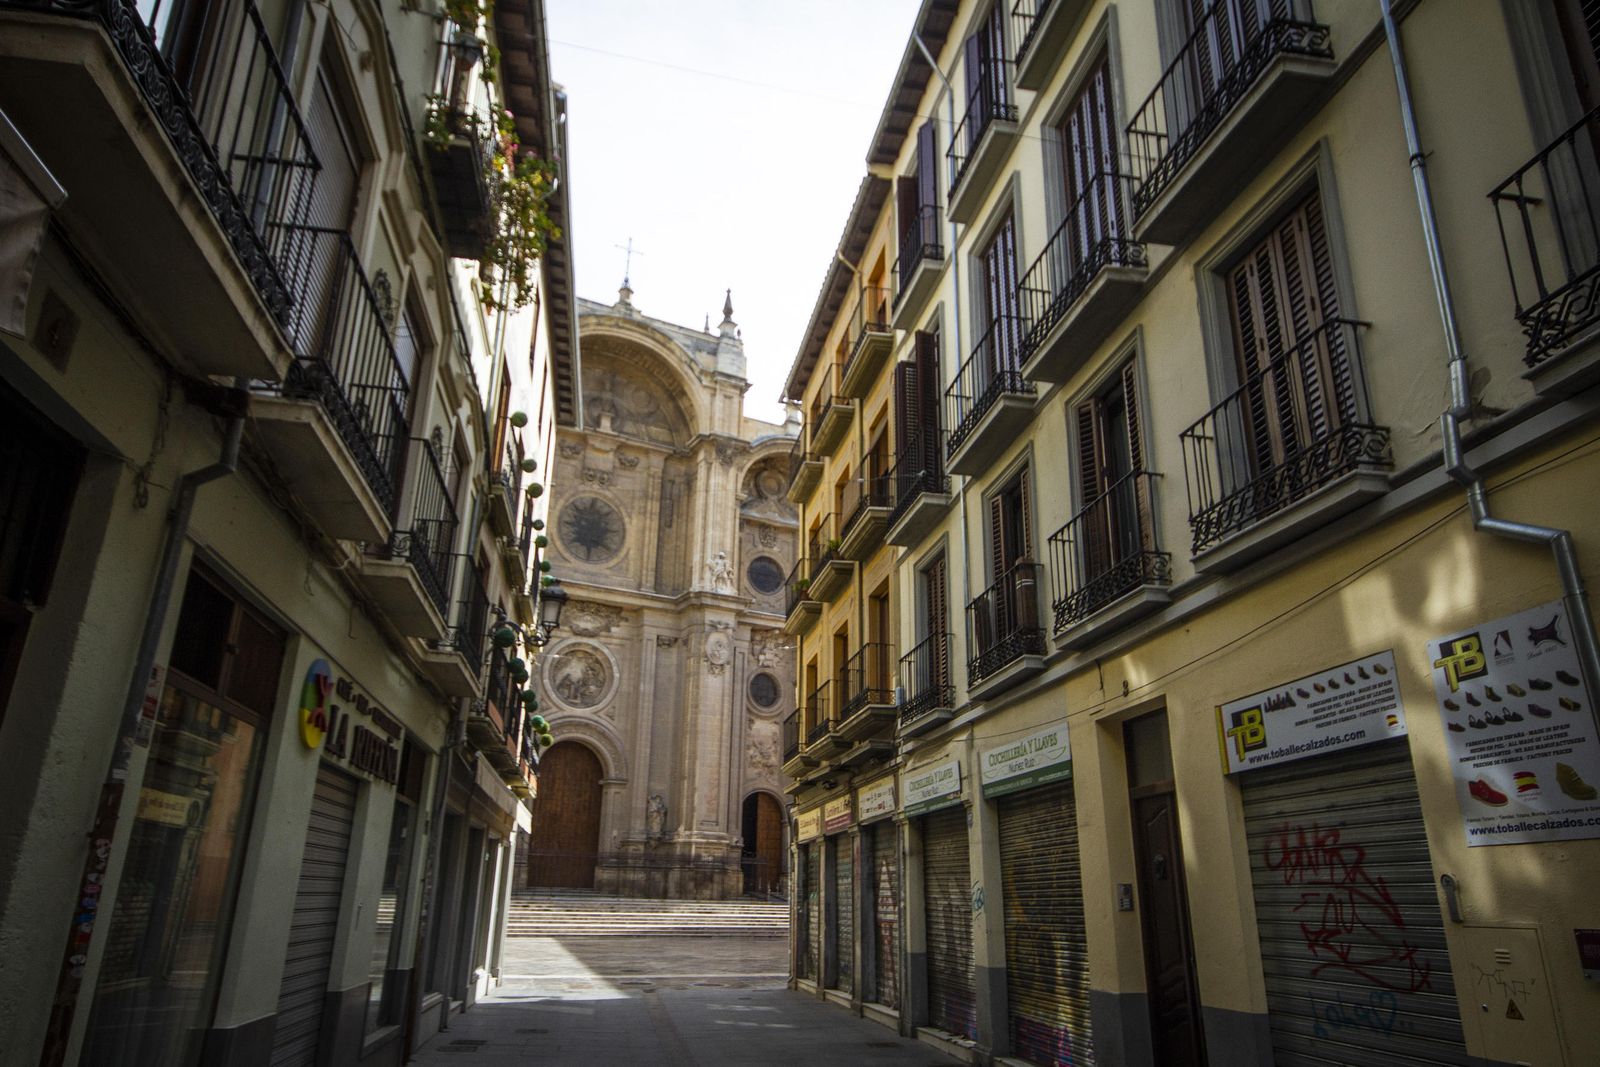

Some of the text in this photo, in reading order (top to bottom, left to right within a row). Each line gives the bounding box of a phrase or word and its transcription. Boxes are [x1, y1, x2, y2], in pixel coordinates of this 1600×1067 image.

[326, 704, 348, 758] LA
[1028, 740, 1034, 754] Y
[1034, 732, 1058, 752] LLAVES
[1248, 729, 1366, 764] www.toballecalzados.com
